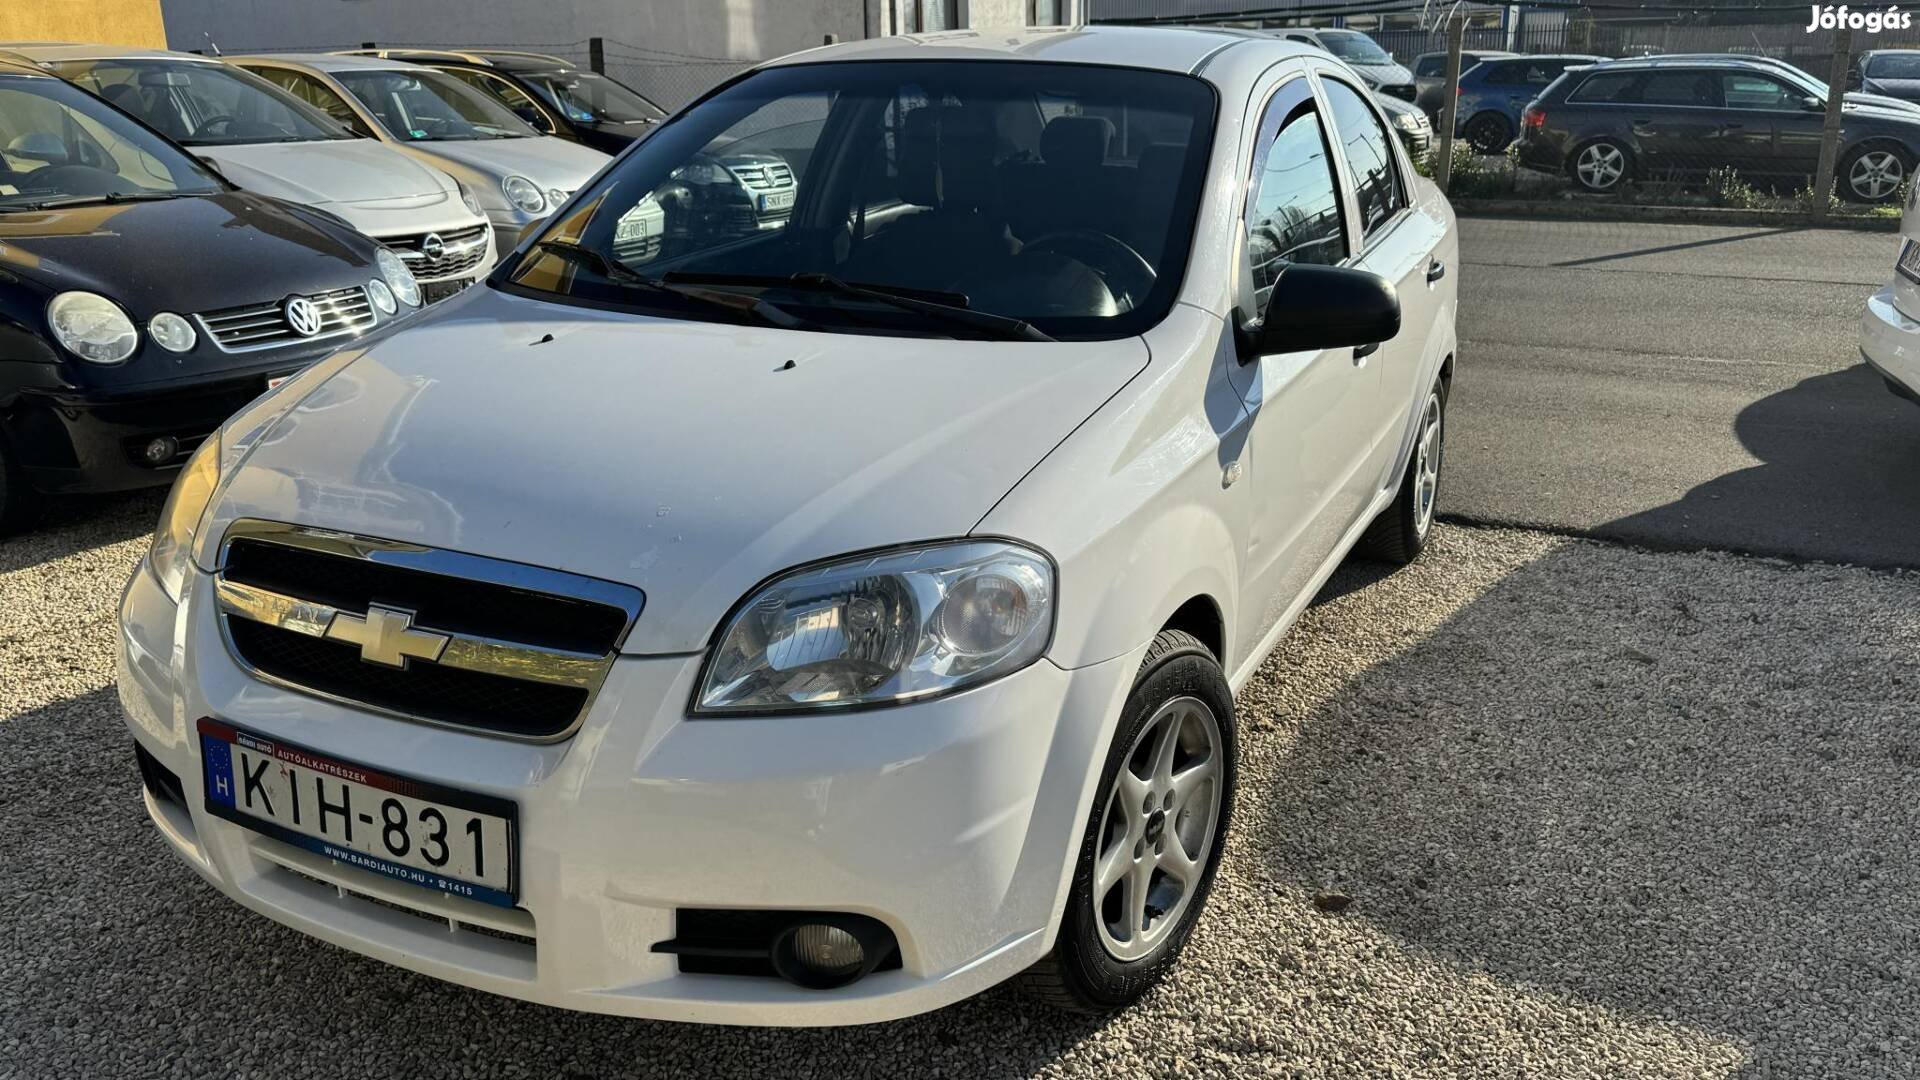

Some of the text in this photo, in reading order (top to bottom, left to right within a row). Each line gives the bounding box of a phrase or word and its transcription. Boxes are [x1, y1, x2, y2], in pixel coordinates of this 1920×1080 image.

[277, 750, 367, 783] AUTÓALKATRÉSZEK
[216, 774, 229, 798] H
[241, 752, 484, 877] KIH-831
[324, 845, 425, 883] WWW.BARDIAUTO.HU
